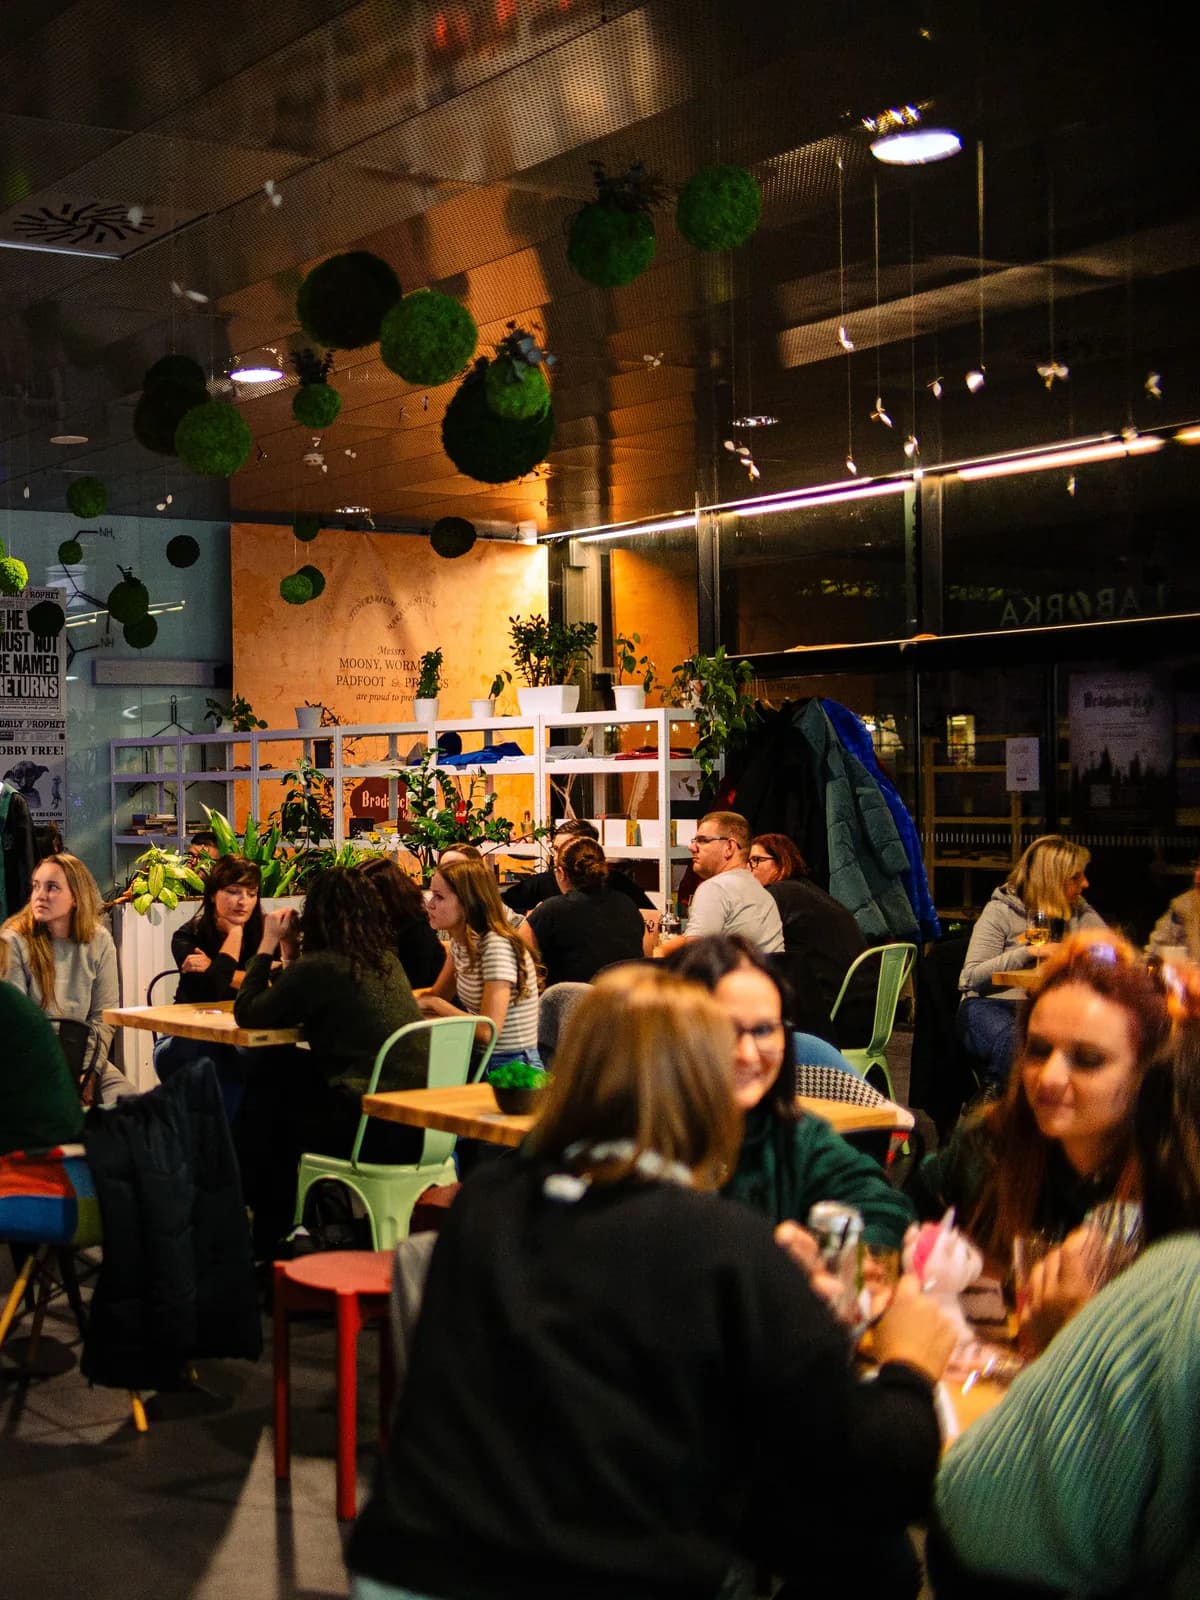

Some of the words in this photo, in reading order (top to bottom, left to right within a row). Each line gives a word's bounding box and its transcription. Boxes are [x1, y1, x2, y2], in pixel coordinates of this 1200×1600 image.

[6, 609, 24, 630] HE
[13, 654, 59, 675] NAMED
[339, 658, 382, 671] MOONY,
[336, 675, 386, 687] PADFOOT
[355, 693, 367, 701] are
[369, 692, 390, 703] proud
[0, 720, 24, 729] DAILY
[31, 745, 64, 756] FREE!
